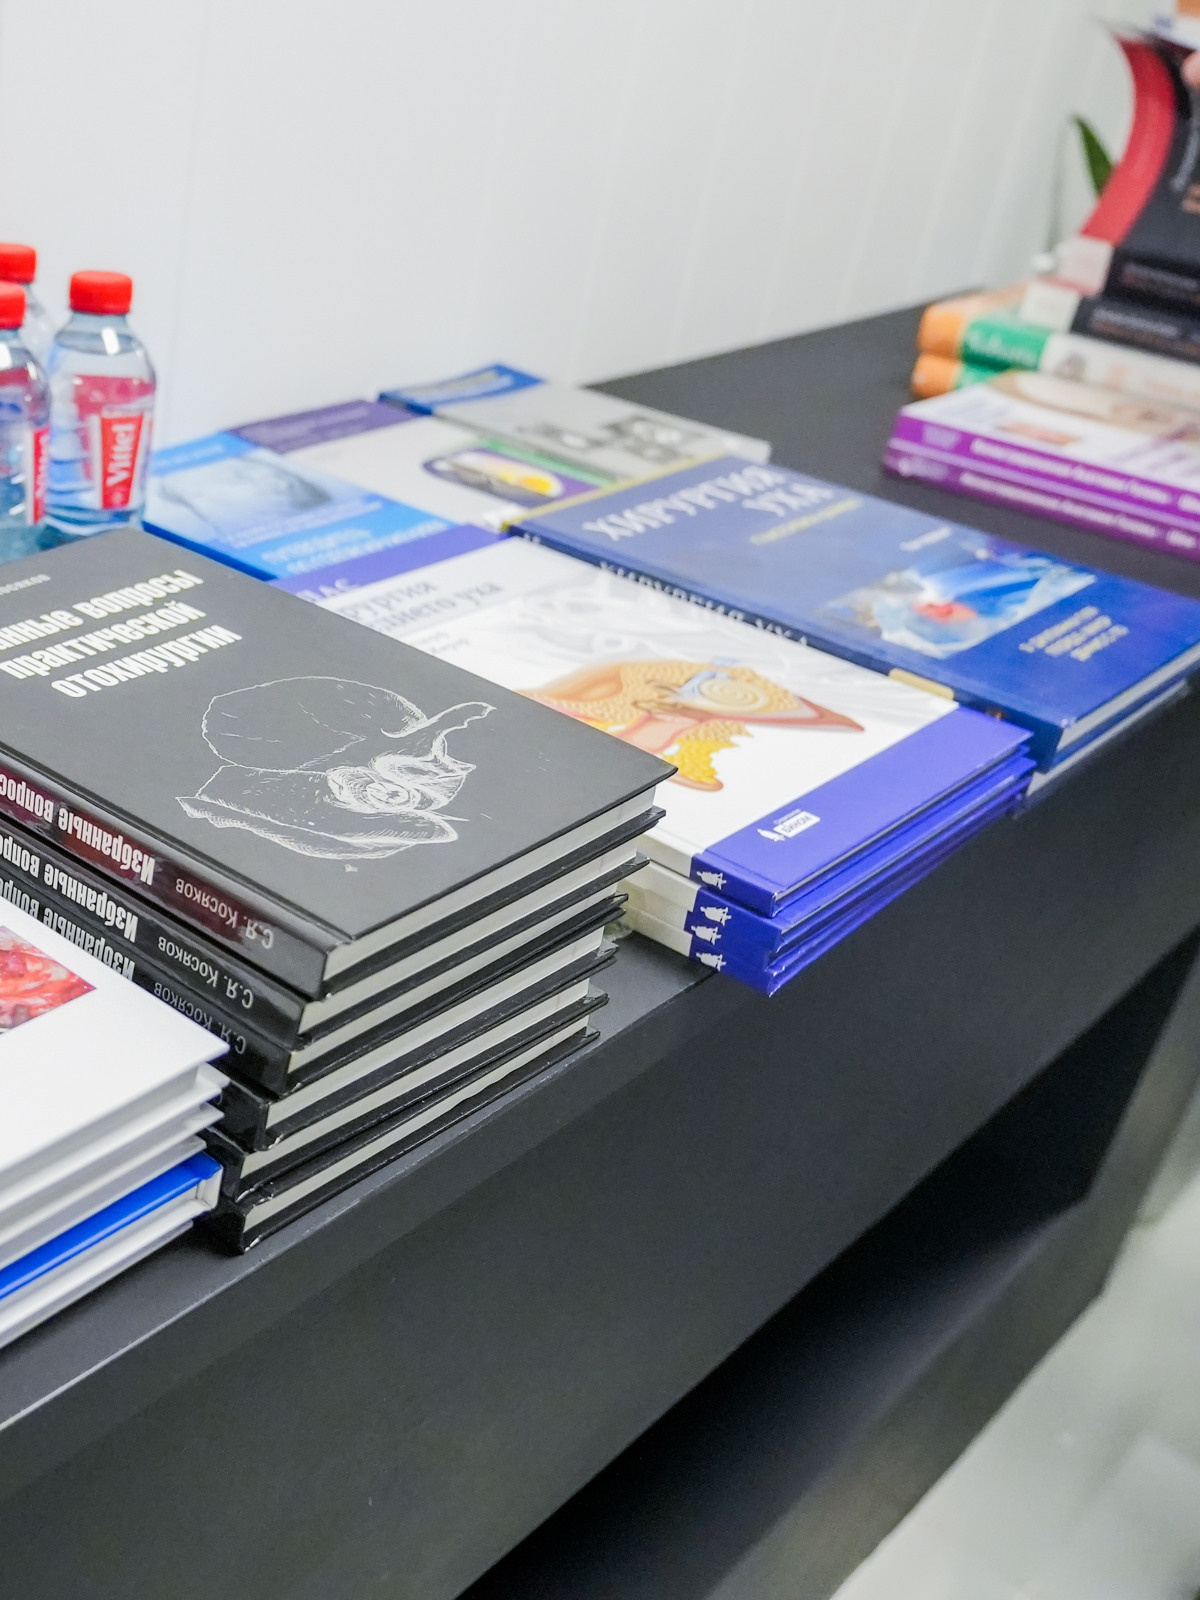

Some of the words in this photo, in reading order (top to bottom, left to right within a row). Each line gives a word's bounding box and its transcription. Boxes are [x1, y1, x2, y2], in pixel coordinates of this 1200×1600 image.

[106, 423, 136, 487] Vittel
[72, 568, 204, 620] вопросы
[50, 624, 243, 699] отохирургии
[58, 806, 156, 886] Избранные
[43, 863, 139, 943] Избранные
[223, 974, 255, 1010] С.Я.
